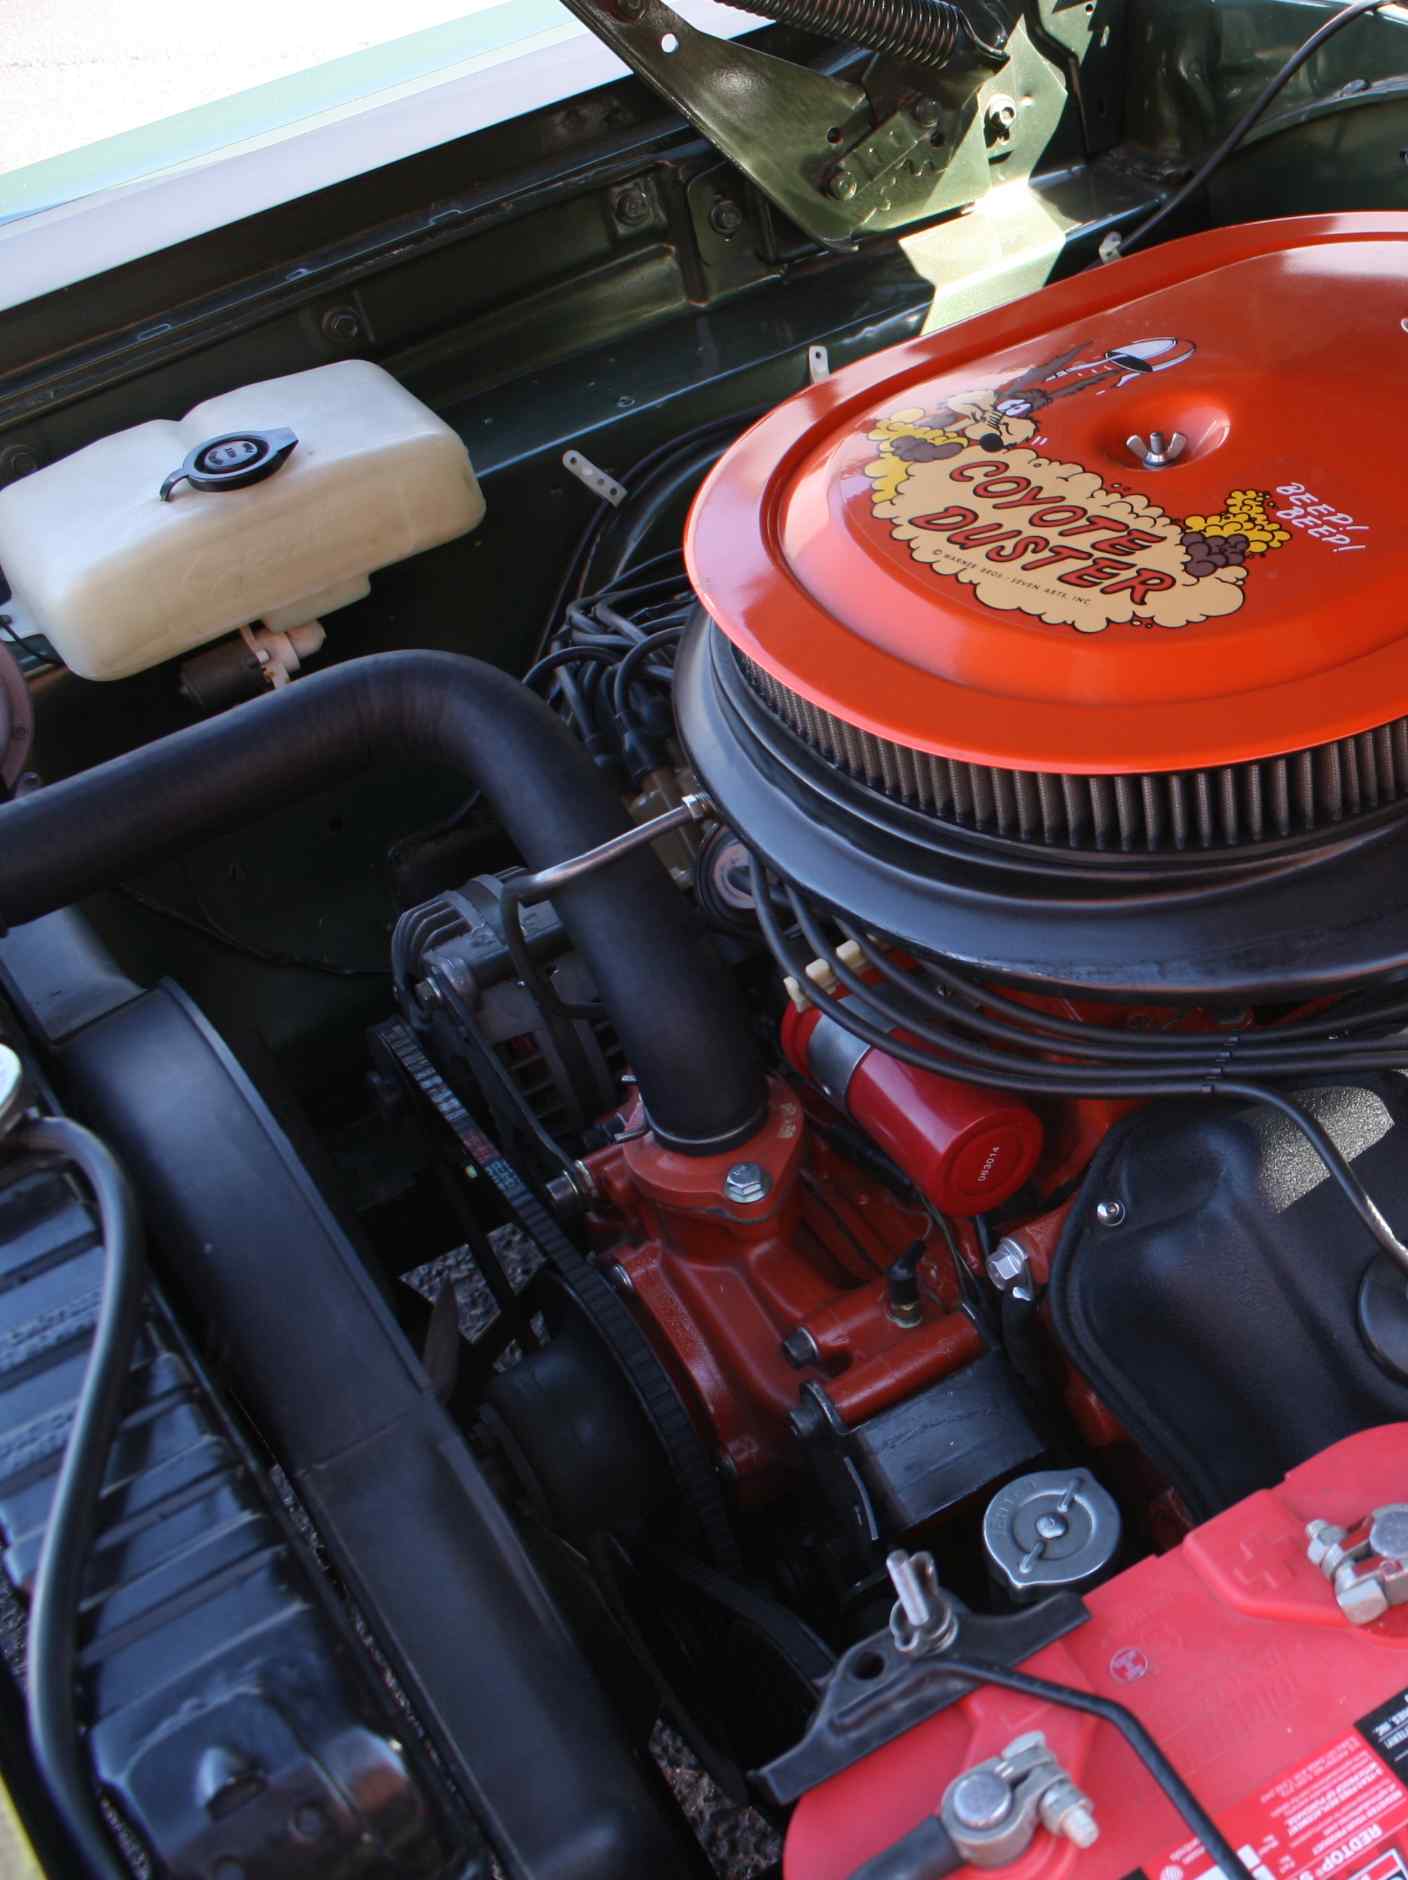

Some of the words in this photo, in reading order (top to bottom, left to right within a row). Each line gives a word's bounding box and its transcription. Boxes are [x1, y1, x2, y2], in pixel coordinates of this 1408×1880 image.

[950, 460, 1167, 556] COYOTE
[1276, 482, 1370, 531] BEEP!
[1276, 506, 1366, 552] BEEP!
[908, 505, 1176, 606] DUSTER
